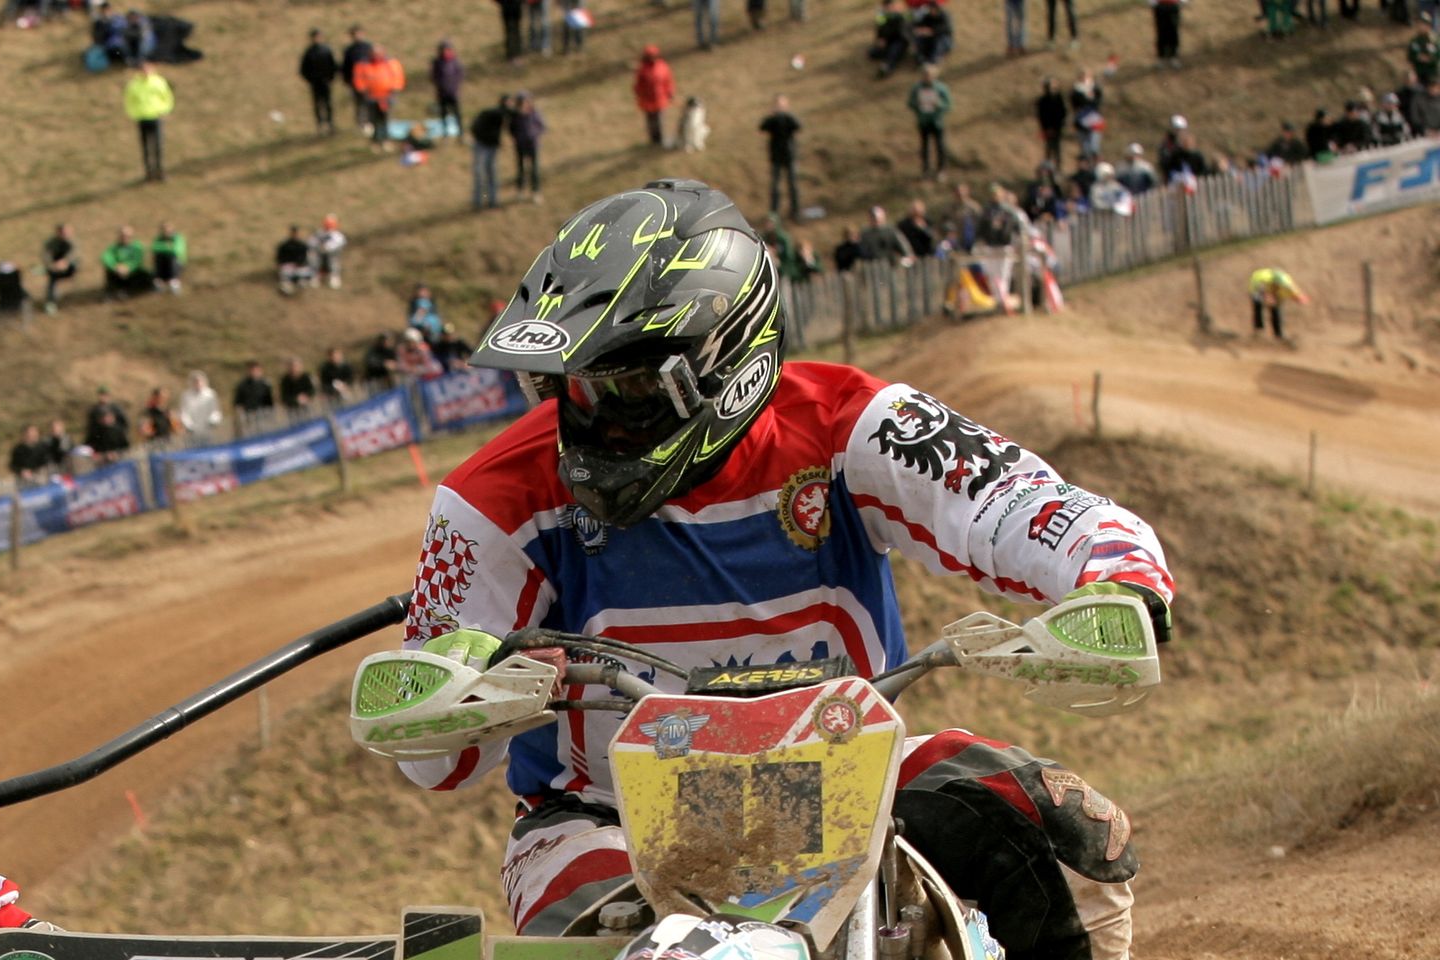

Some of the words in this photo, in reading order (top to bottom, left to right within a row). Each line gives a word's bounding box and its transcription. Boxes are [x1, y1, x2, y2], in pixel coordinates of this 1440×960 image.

[497, 325, 560, 345] Arai
[726, 360, 766, 413] Arai
[707, 668, 824, 686] ACERBIS
